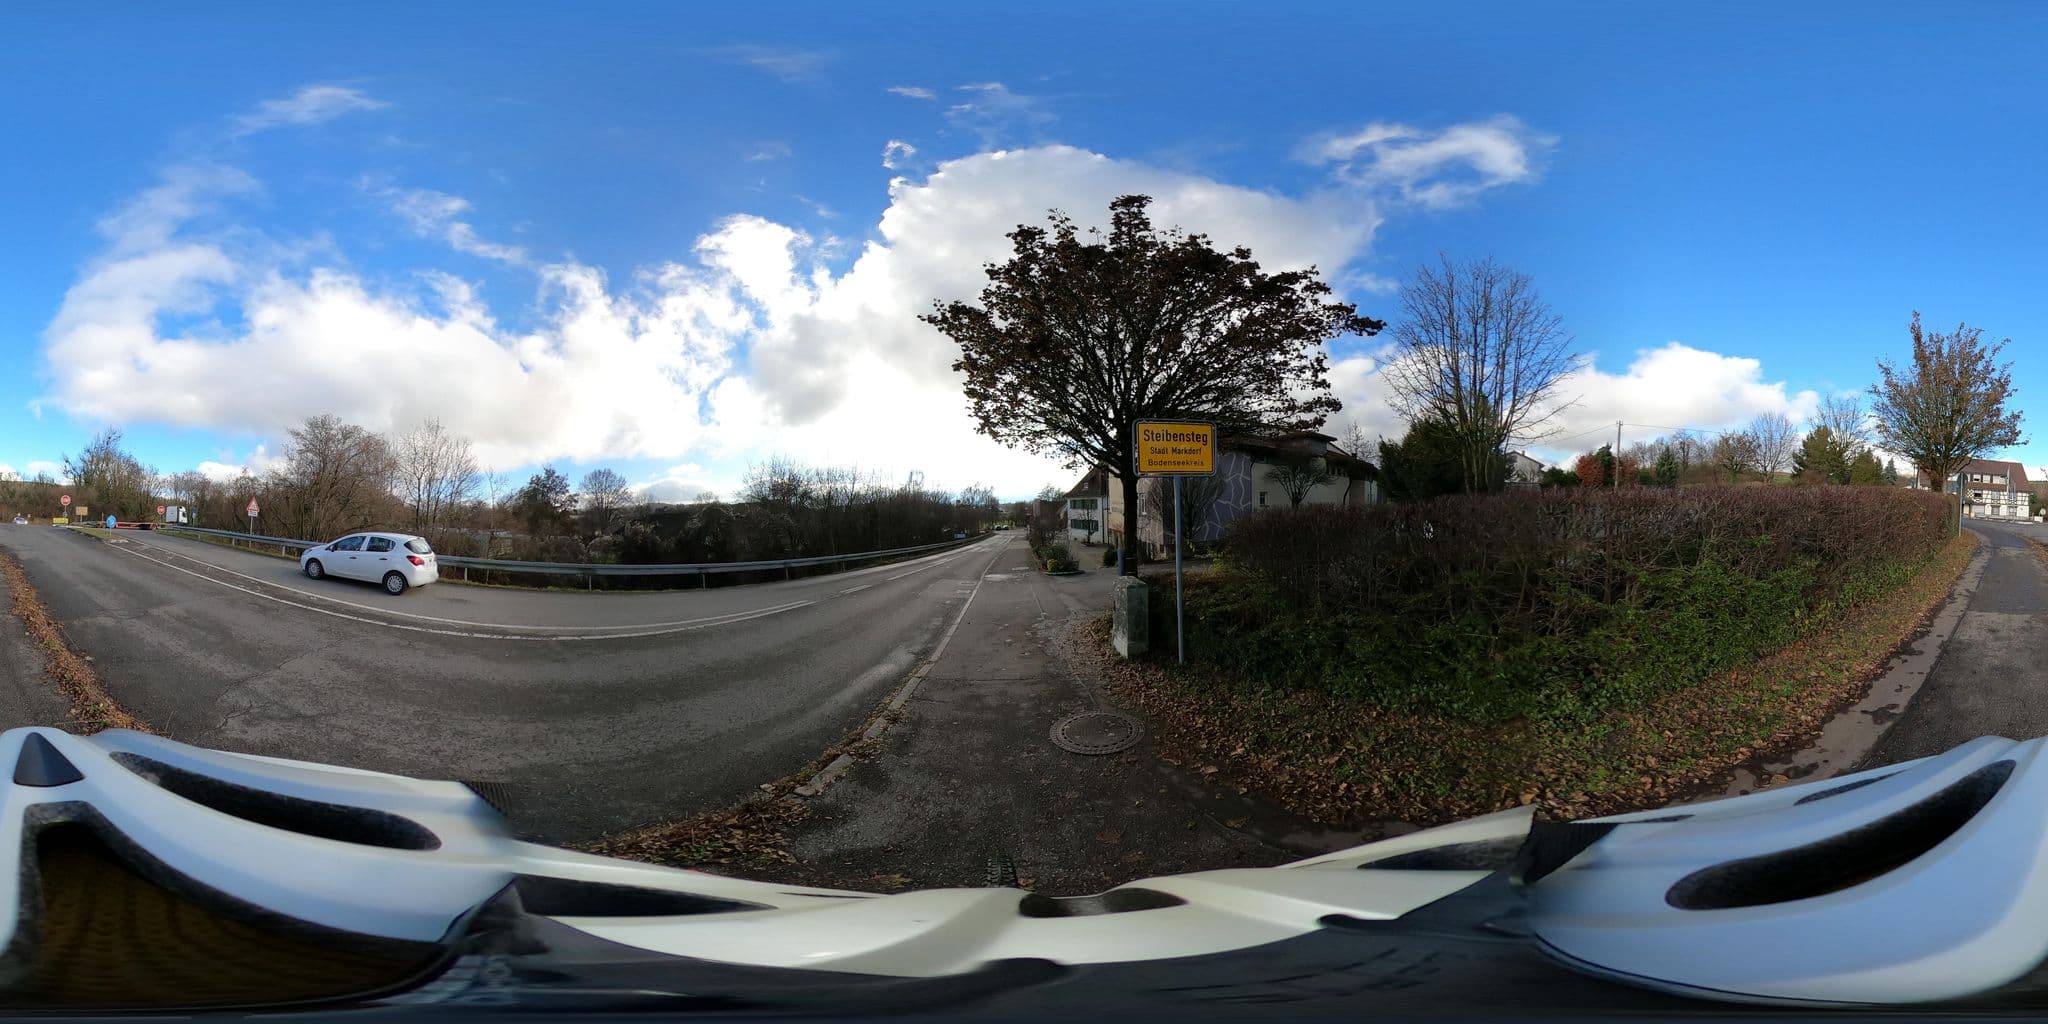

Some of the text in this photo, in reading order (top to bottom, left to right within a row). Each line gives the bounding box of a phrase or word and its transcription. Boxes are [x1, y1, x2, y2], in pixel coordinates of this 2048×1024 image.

[1143, 429, 1208, 446] Steibensteg
[1150, 447, 1202, 455] Stadt Markdorf
[1148, 459, 1204, 467] Bodenseekreis
